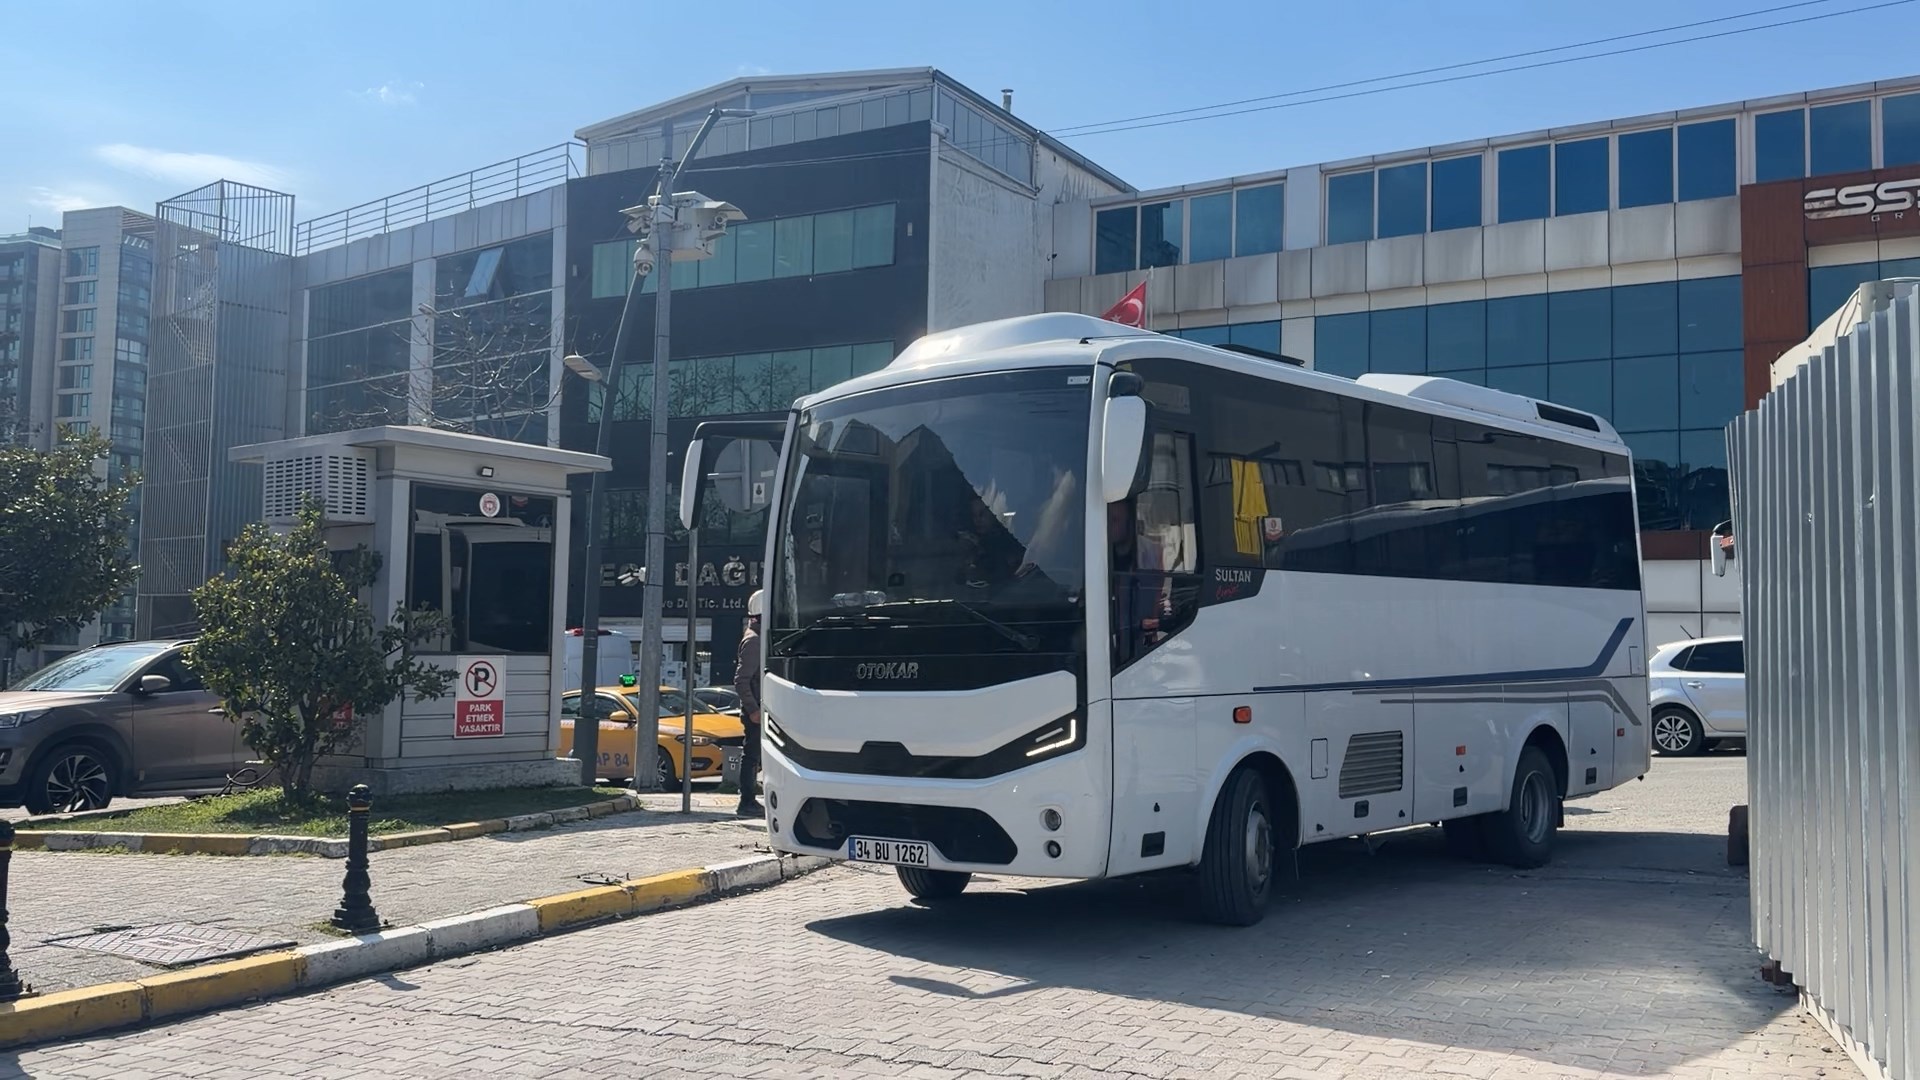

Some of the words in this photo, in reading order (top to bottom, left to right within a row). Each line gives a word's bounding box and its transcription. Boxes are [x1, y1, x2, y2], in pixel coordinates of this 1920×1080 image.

[1804, 178, 1920, 220] ESS
[1871, 211, 1920, 222] GR
[674, 555, 765, 587] DAĞI
[1215, 568, 1251, 583] SULTAN
[722, 597, 745, 609] Ltd.
[857, 662, 919, 680] OTOKAR
[469, 703, 492, 713] PARK
[465, 713, 495, 723] ETMEK
[459, 723, 501, 733] YASAKTIR
[614, 752, 630, 767] 84
[856, 840, 870, 859] 34
[875, 842, 889, 861] BU
[895, 843, 925, 864] 1262
